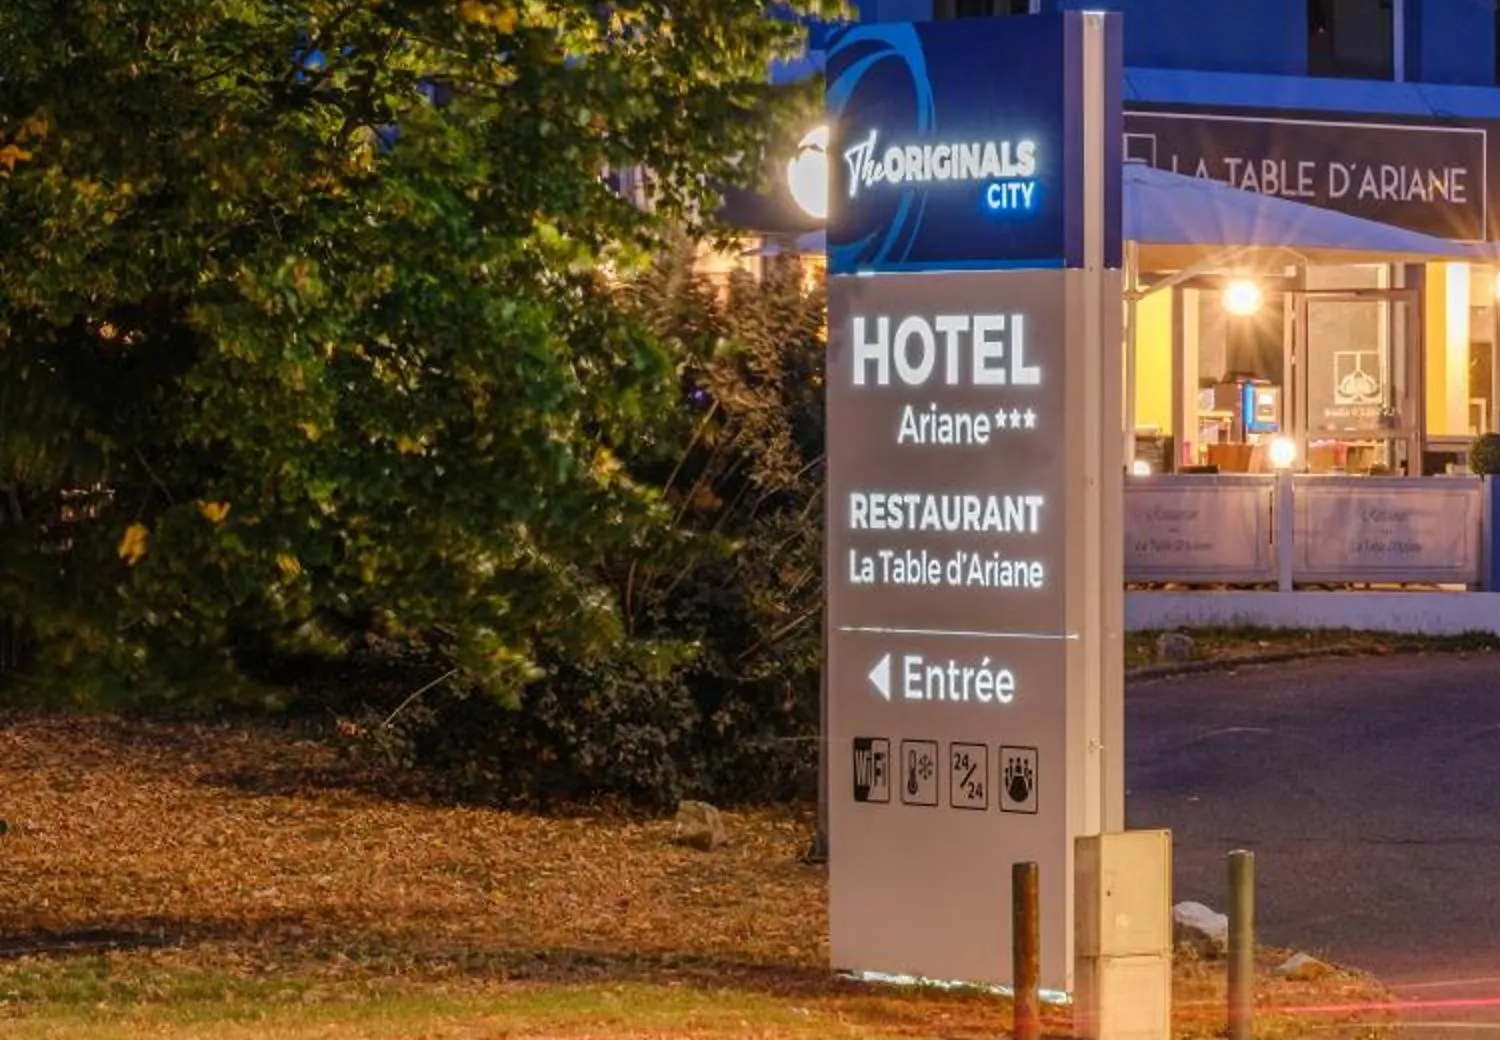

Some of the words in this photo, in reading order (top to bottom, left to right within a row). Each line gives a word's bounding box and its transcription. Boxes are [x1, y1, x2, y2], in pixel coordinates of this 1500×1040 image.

[844, 128, 885, 198] The
[883, 139, 1036, 183] ORIGINALS
[1222, 157, 1316, 197] TABLE
[1328, 163, 1468, 203] D'ARIANE
[987, 181, 1035, 209] CITY
[853, 314, 1041, 385] HOTEL
[897, 403, 991, 444] Ariane
[849, 492, 1045, 534] RESTAURANT
[849, 549, 875, 584] La
[878, 549, 942, 585] Table
[946, 550, 1044, 589] d'Ariane
[904, 655, 1015, 704] Entrée
